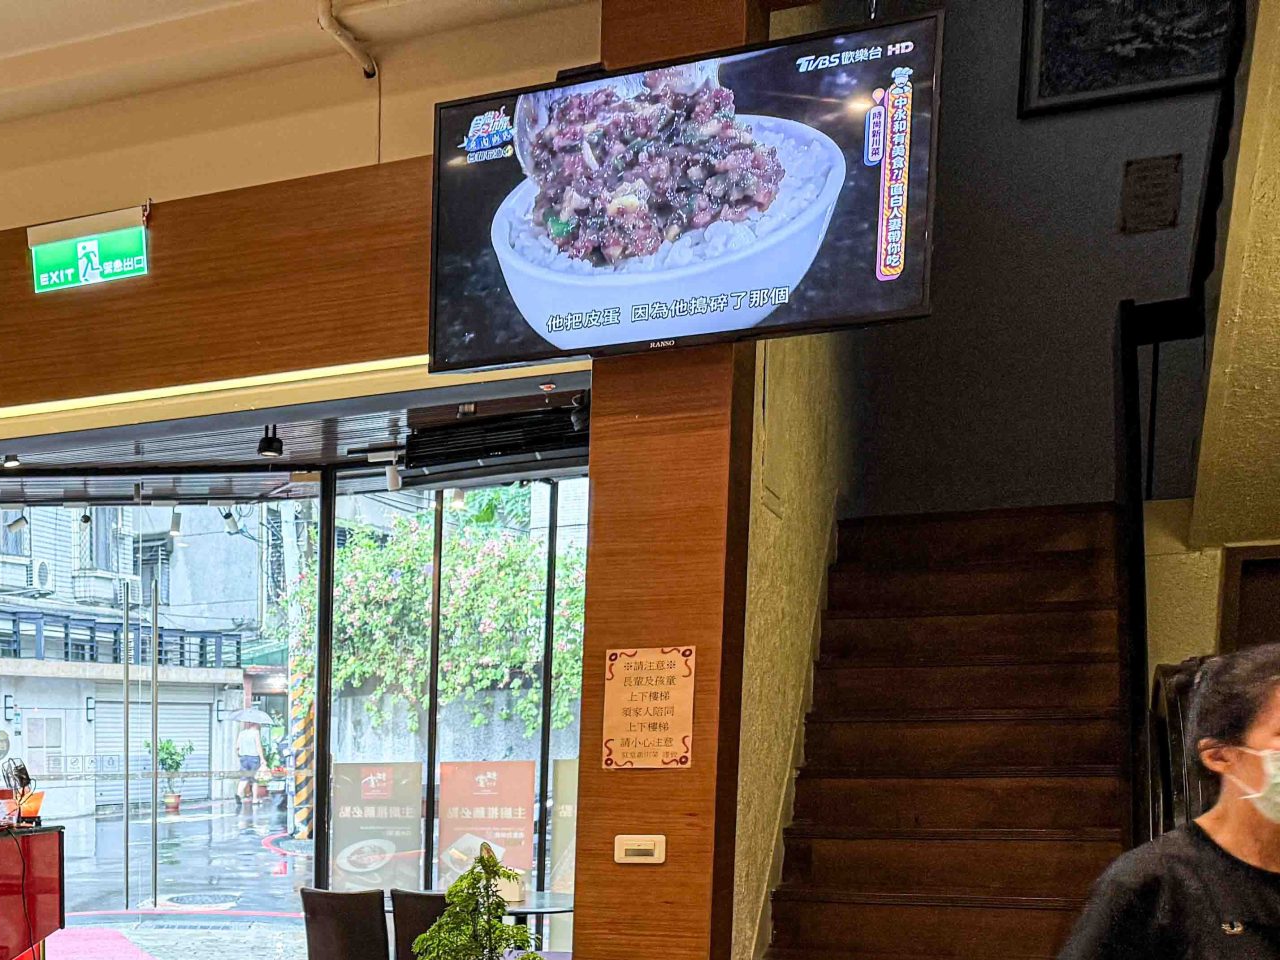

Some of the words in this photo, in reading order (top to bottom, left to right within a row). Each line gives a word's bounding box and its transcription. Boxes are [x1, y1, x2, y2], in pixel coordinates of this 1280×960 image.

[796, 53, 841, 73] TVBS
[842, 47, 882, 65] 歡樂台
[887, 42, 914, 56] HD
[40, 268, 75, 286] EXIT
[103, 256, 144, 274] 緊急出口
[546, 307, 621, 333] 他把皮蛋
[630, 286, 790, 322] 因為他搗碎了那個
[627, 691, 670, 702] 上下樓梯
[626, 721, 669, 733] 上下樓梯
[620, 736, 674, 748] 請小心注意
